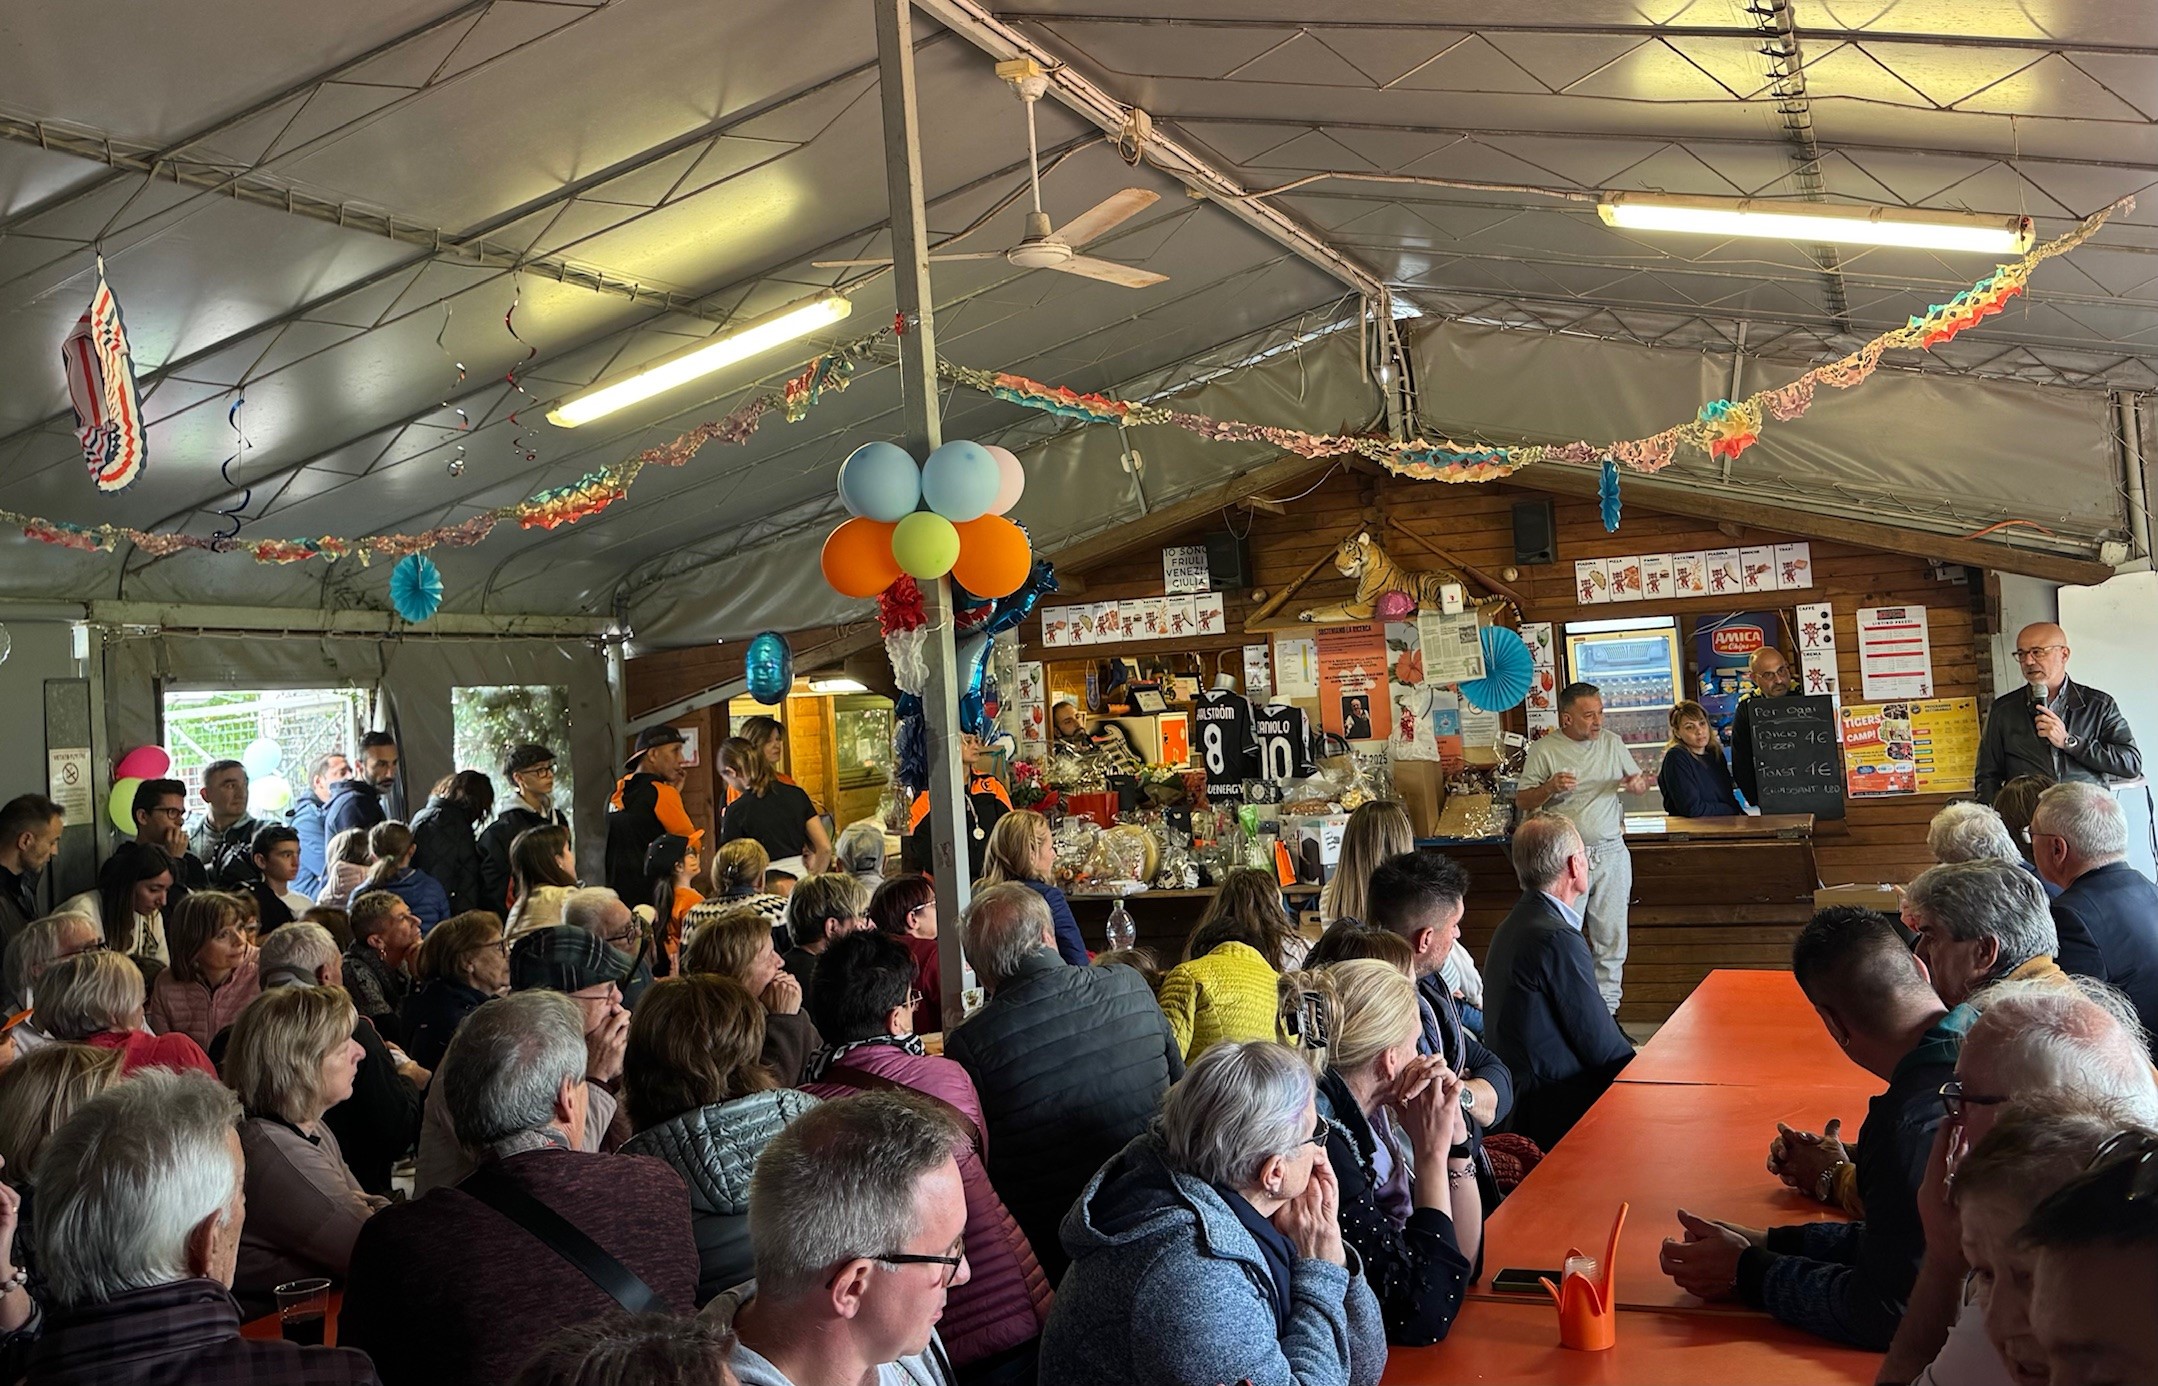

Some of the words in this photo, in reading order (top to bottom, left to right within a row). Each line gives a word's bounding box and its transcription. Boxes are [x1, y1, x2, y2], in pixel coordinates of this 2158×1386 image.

[1164, 548, 1176, 557] IO
[1172, 556, 1204, 567] FRIULI
[1715, 631, 1761, 644] AMICA
[1843, 714, 1881, 728] TIGERS
[1846, 729, 1877, 742] CAMP!
[1204, 723, 1225, 775] 8
[1759, 742, 1796, 750] PIZZA
[1259, 736, 1293, 787] 10
